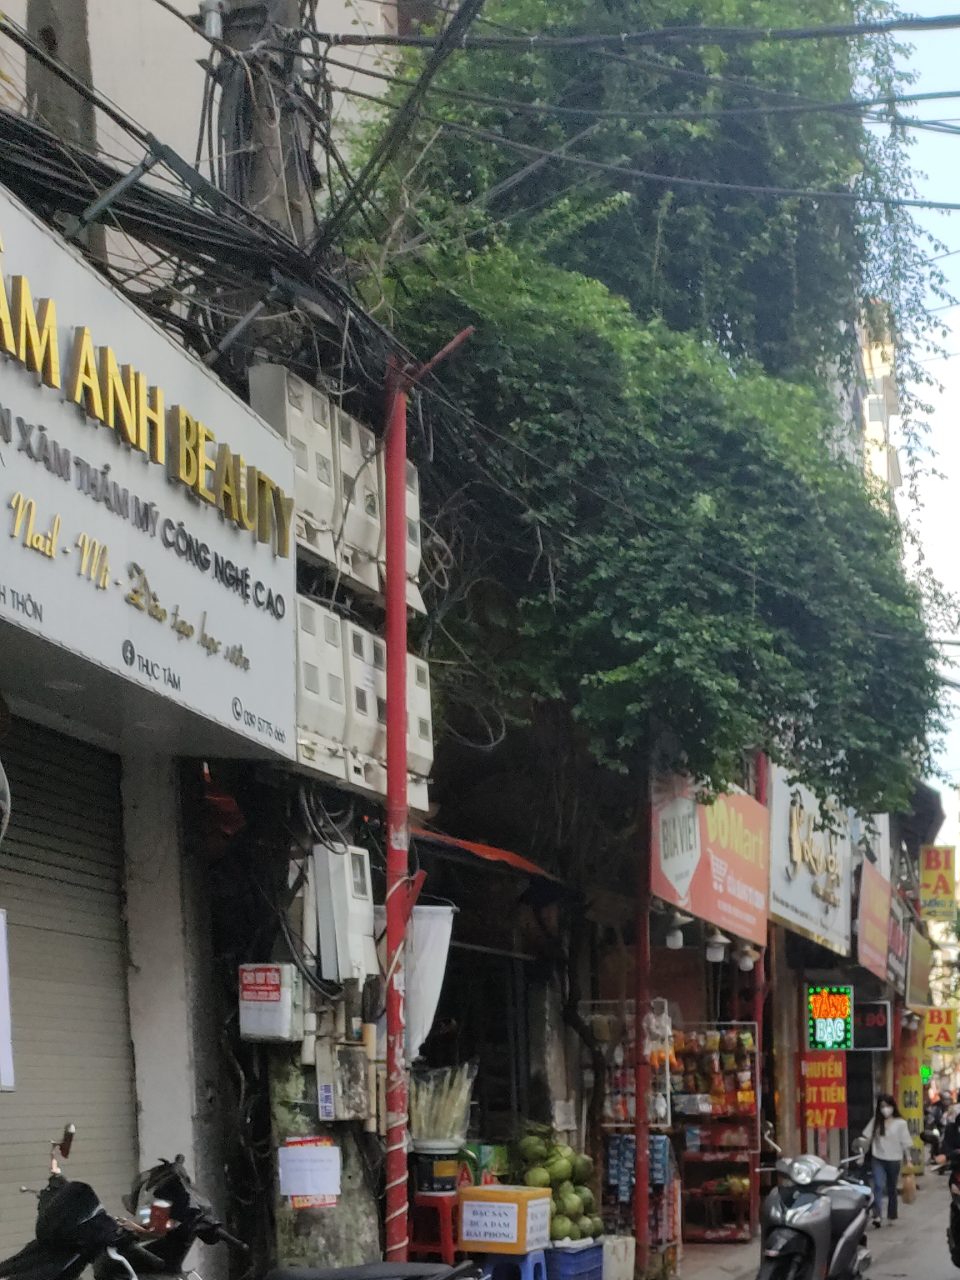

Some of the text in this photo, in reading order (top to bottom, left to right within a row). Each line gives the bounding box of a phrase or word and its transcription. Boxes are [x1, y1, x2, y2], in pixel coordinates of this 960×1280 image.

[68, 325, 165, 465] ANH
[168, 404, 294, 557] BEAUTY
[8, 491, 61, 559] Nail
[161, 518, 211, 571] CÔNG
[252, 580, 286, 620] CAO
[10, 588, 43, 622] THÔN
[925, 846, 952, 868] BI
[816, 1018, 845, 1047] BẠC
[929, 1009, 953, 1025] BI
[806, 1108, 837, 1128] 24/7
